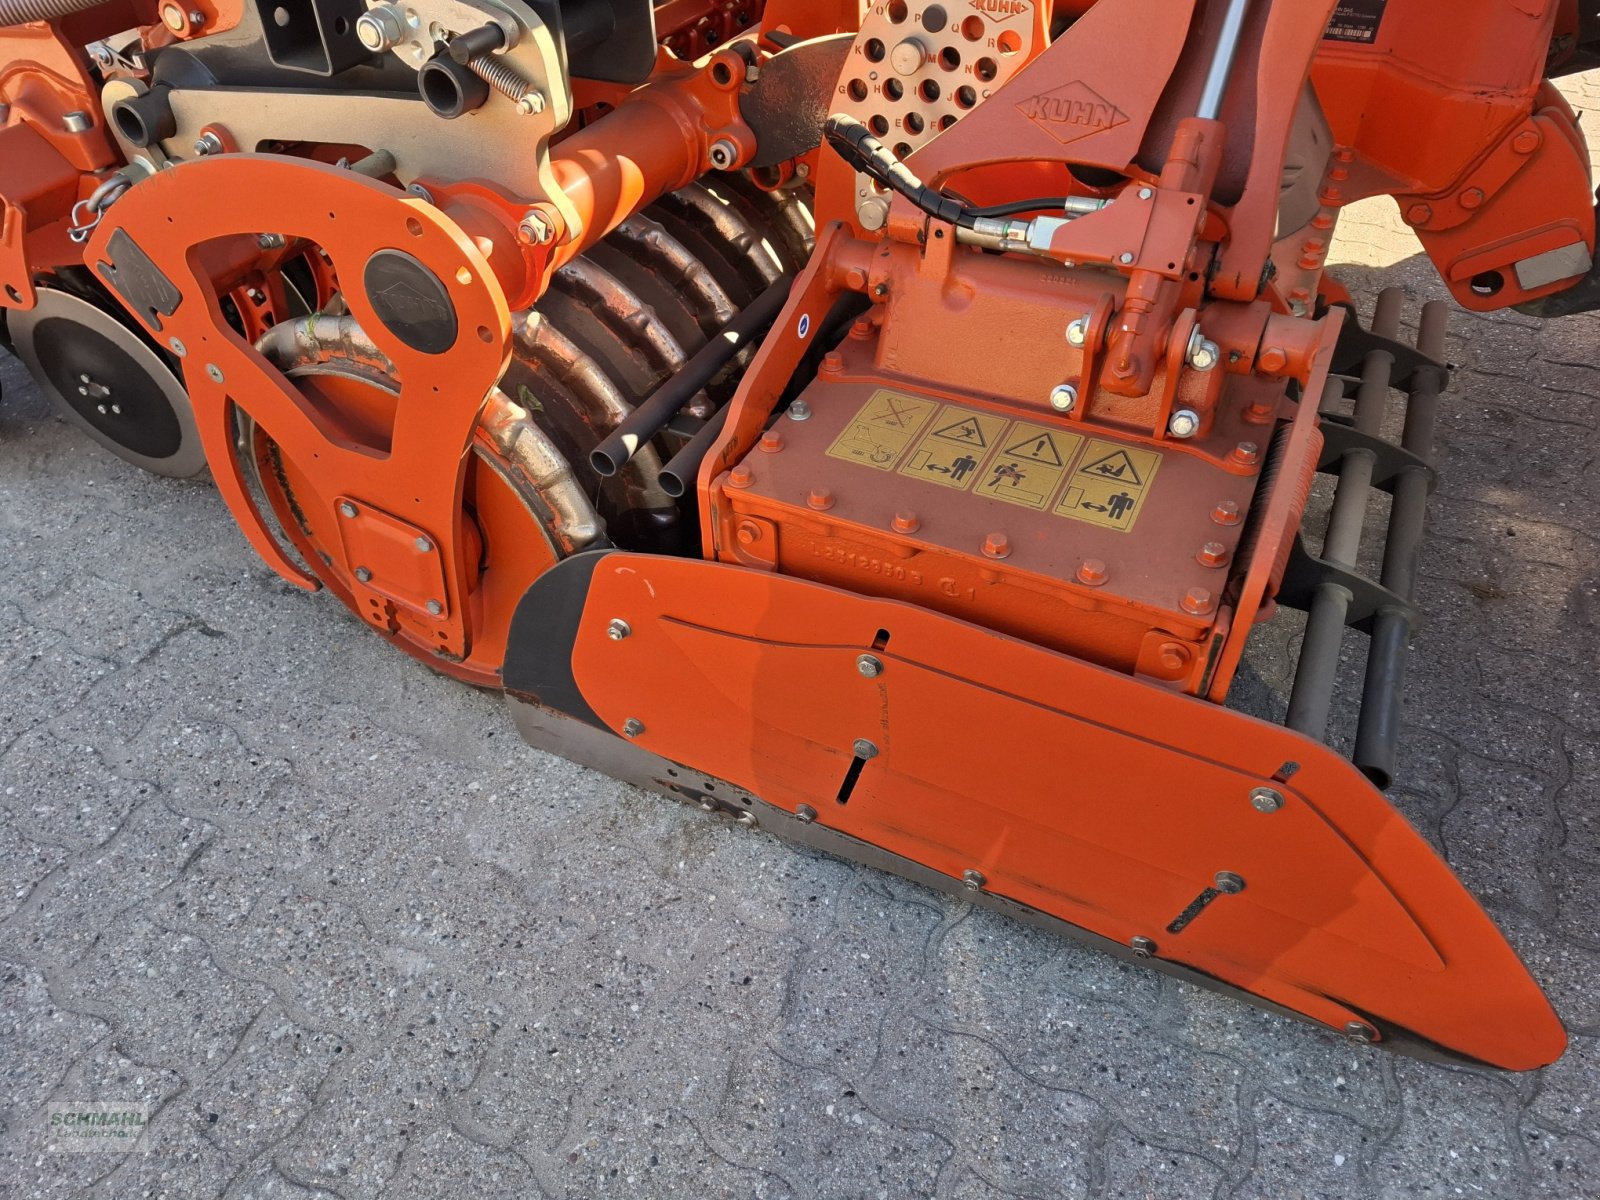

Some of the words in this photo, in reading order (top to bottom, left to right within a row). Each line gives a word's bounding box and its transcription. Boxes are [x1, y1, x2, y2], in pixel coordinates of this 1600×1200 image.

[975, 0, 1021, 14] KUHN
[854, 45, 862, 55] K
[927, 54, 937, 64] M
[964, 65, 973, 74] N
[873, 85, 881, 94] H
[1027, 95, 1118, 129] KUHN
[895, 118, 902, 128] E
[930, 121, 937, 130] F
